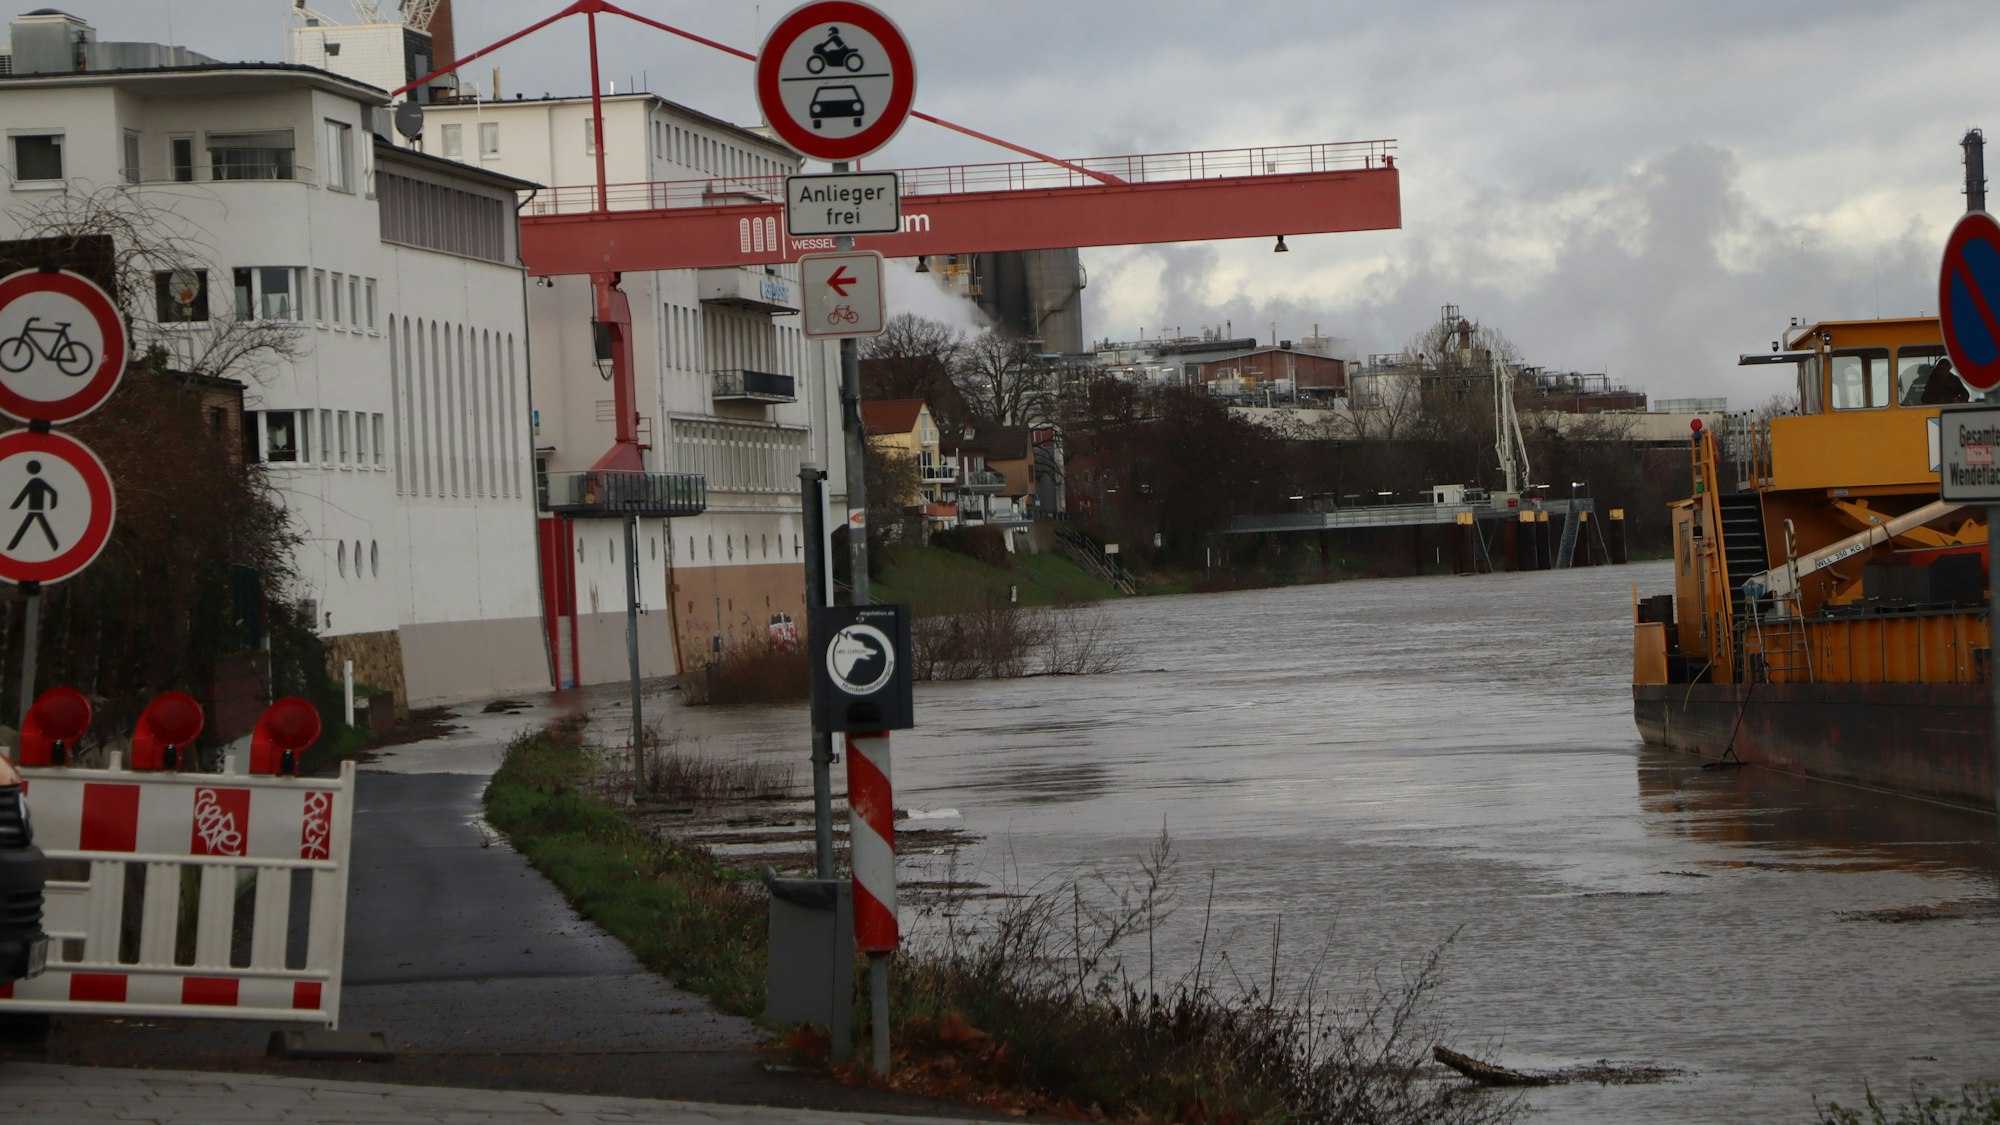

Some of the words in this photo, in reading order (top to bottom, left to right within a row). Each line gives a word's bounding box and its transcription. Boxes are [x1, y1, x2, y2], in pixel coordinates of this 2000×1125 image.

[800, 185, 885, 205] Anlieger
[826, 207, 860, 225] frei
[791, 238, 855, 250] WESSEL
[1816, 558, 1832, 568] WLL
[1835, 550, 1848, 560] 350
[1850, 544, 1862, 553] KG
